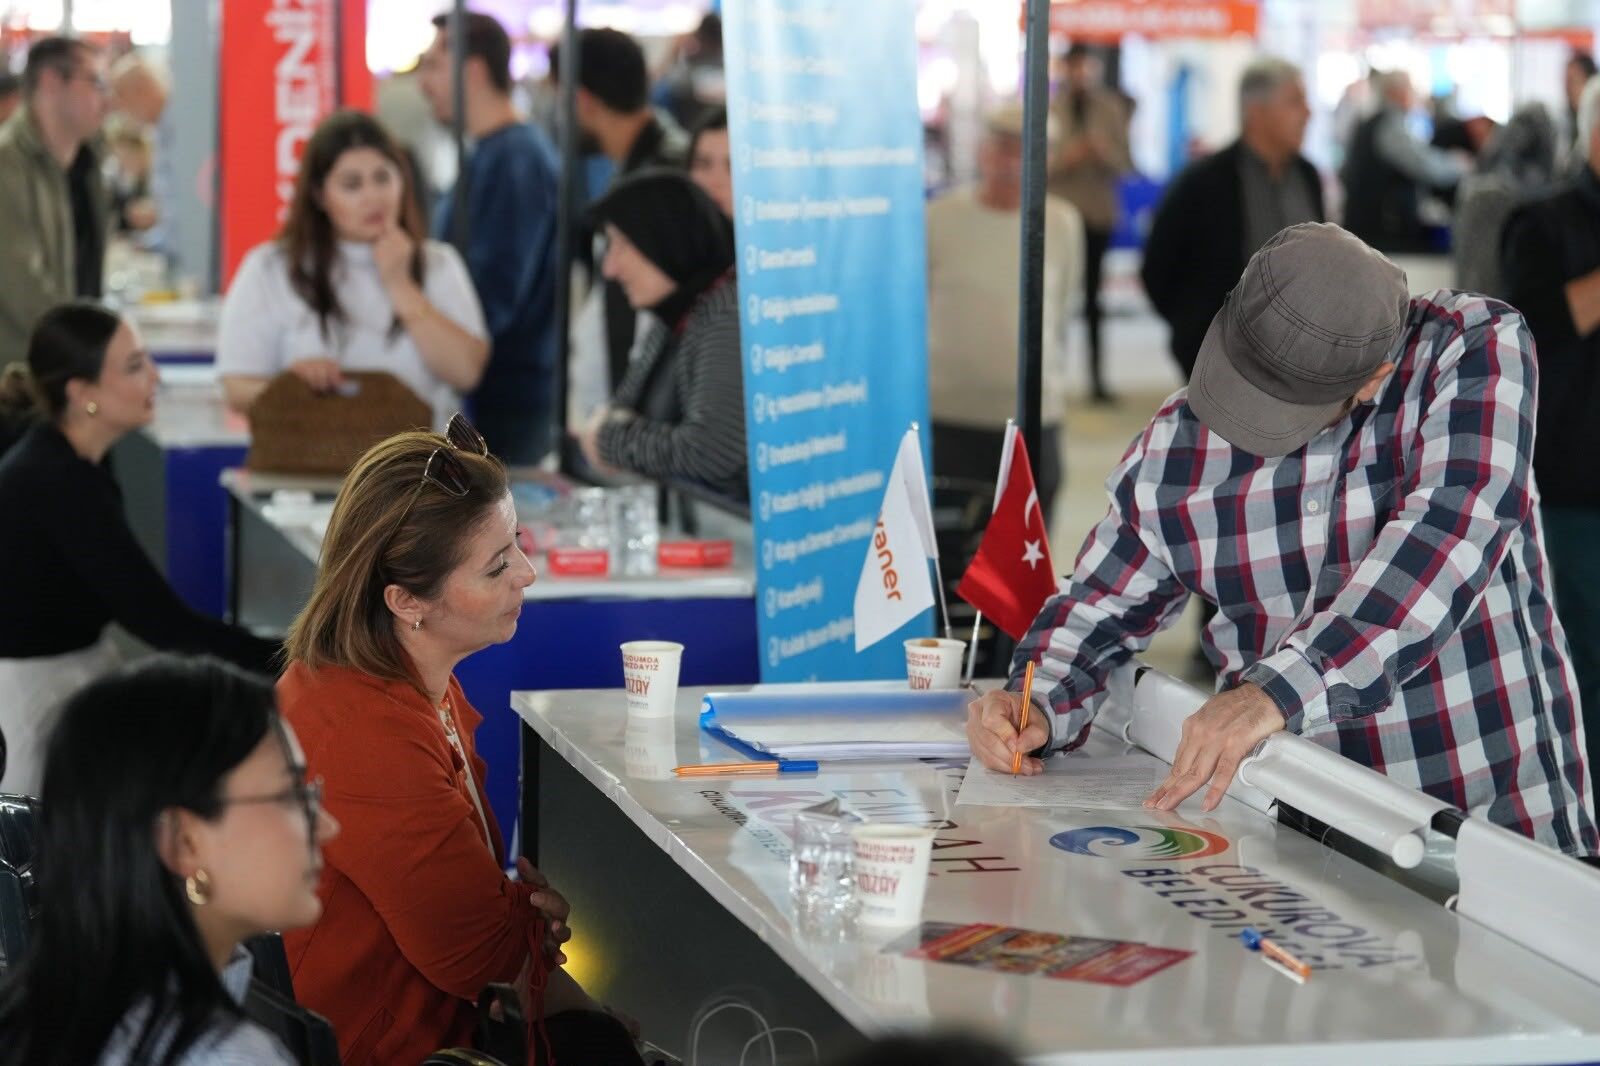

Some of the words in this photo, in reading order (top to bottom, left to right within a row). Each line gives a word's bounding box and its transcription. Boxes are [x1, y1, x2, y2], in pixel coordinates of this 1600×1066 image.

[624, 654, 660, 664] UDUMDA
[625, 677, 650, 696] OZAY
[1180, 864, 1418, 968] ÇUKUROVA
